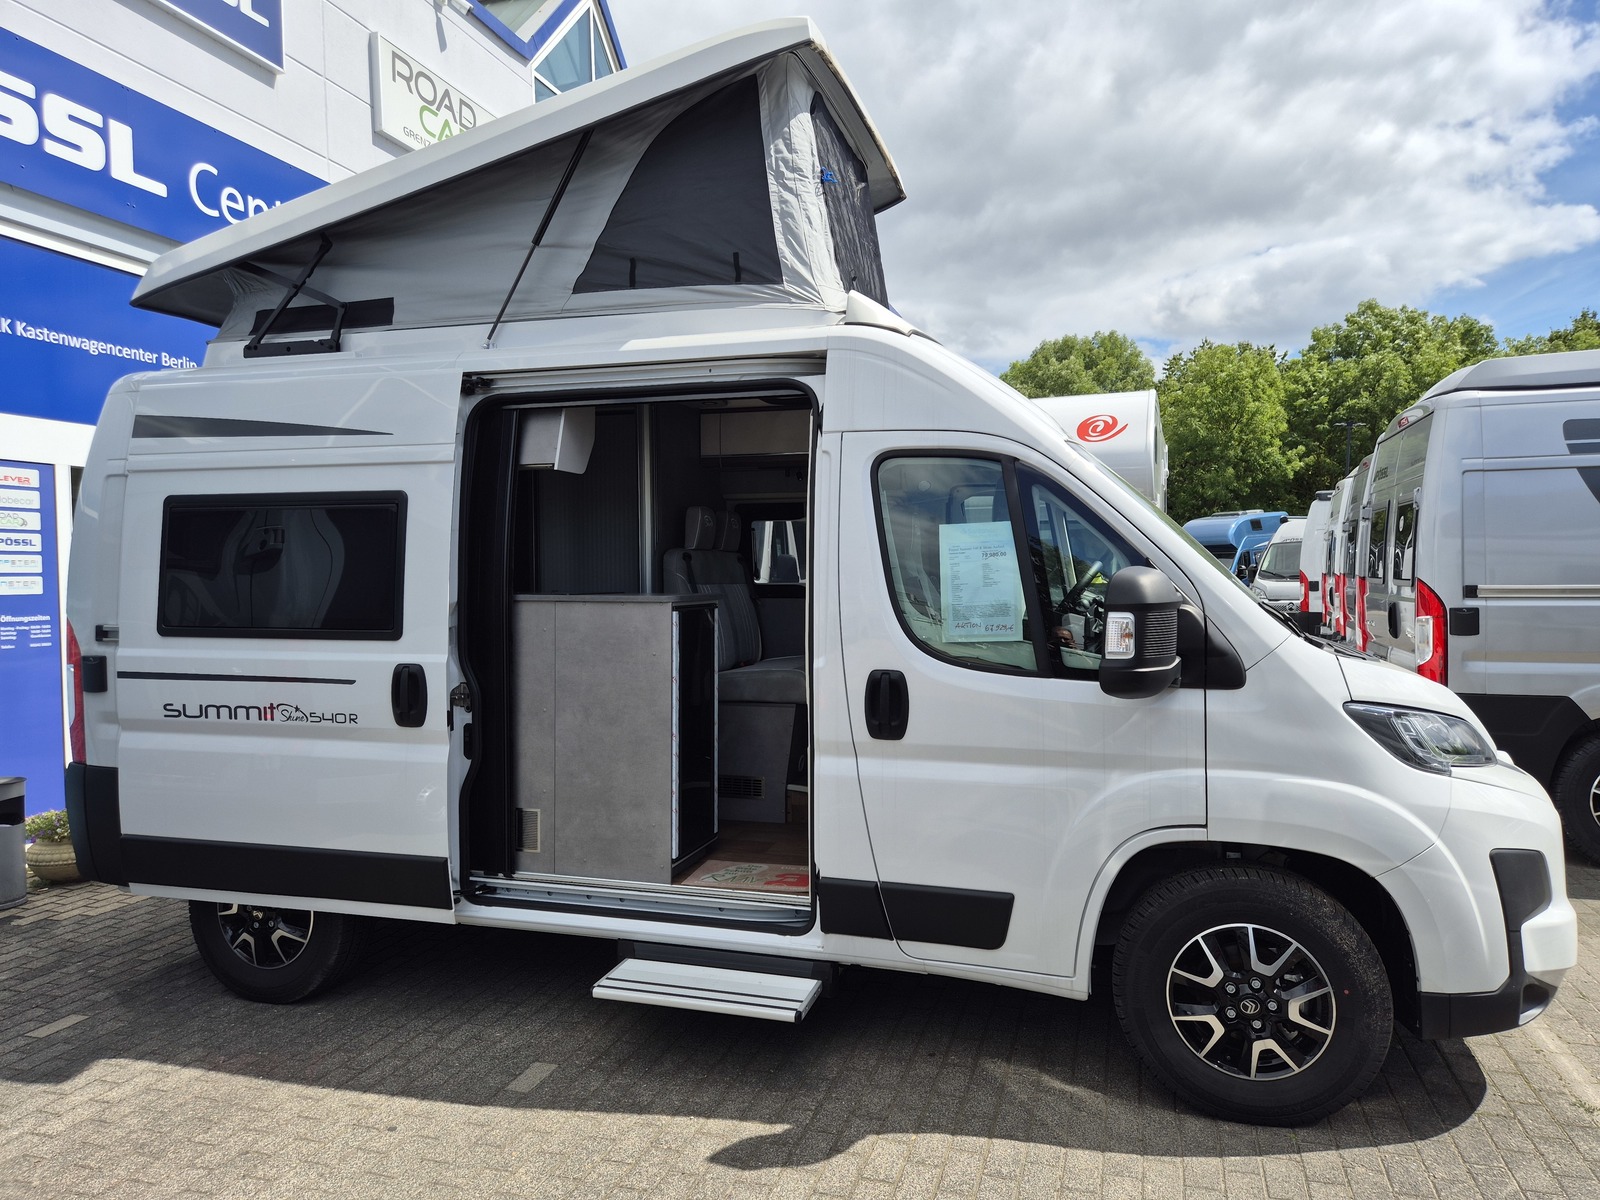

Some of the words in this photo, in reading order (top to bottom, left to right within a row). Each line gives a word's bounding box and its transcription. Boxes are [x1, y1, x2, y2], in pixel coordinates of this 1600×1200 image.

[392, 50, 477, 131] ROAD
[419, 104, 465, 142] CA
[189, 162, 281, 225] Cen
[15, 320, 158, 364] Kastenwagencenter
[161, 352, 197, 369] Berlin
[163, 702, 276, 722] summit
